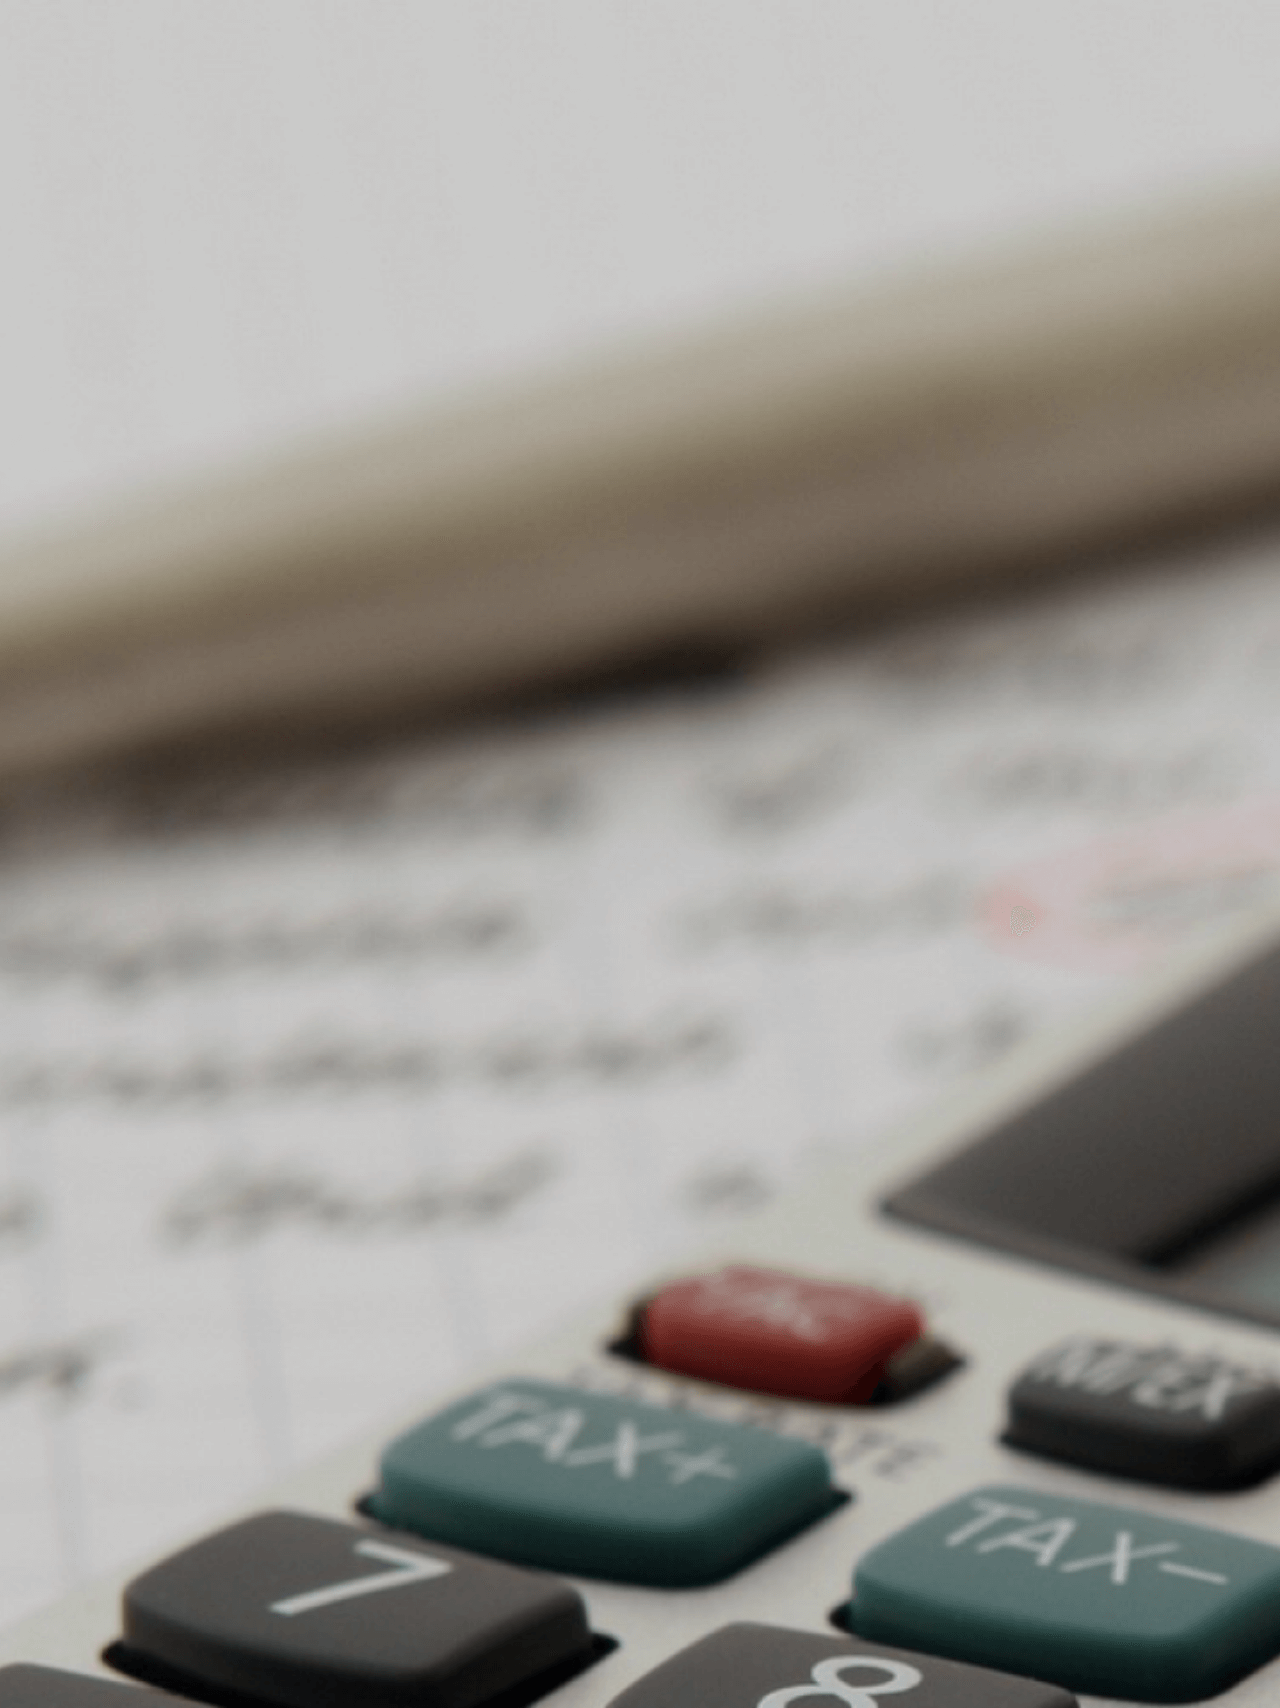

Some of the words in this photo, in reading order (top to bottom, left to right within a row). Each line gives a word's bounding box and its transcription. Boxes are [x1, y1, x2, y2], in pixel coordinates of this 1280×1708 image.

[450, 1392, 736, 1484] TAX+
[270, 1538, 452, 1616] 7
[947, 1499, 1229, 1585] TAX-
[757, 1655, 922, 1708] 8
